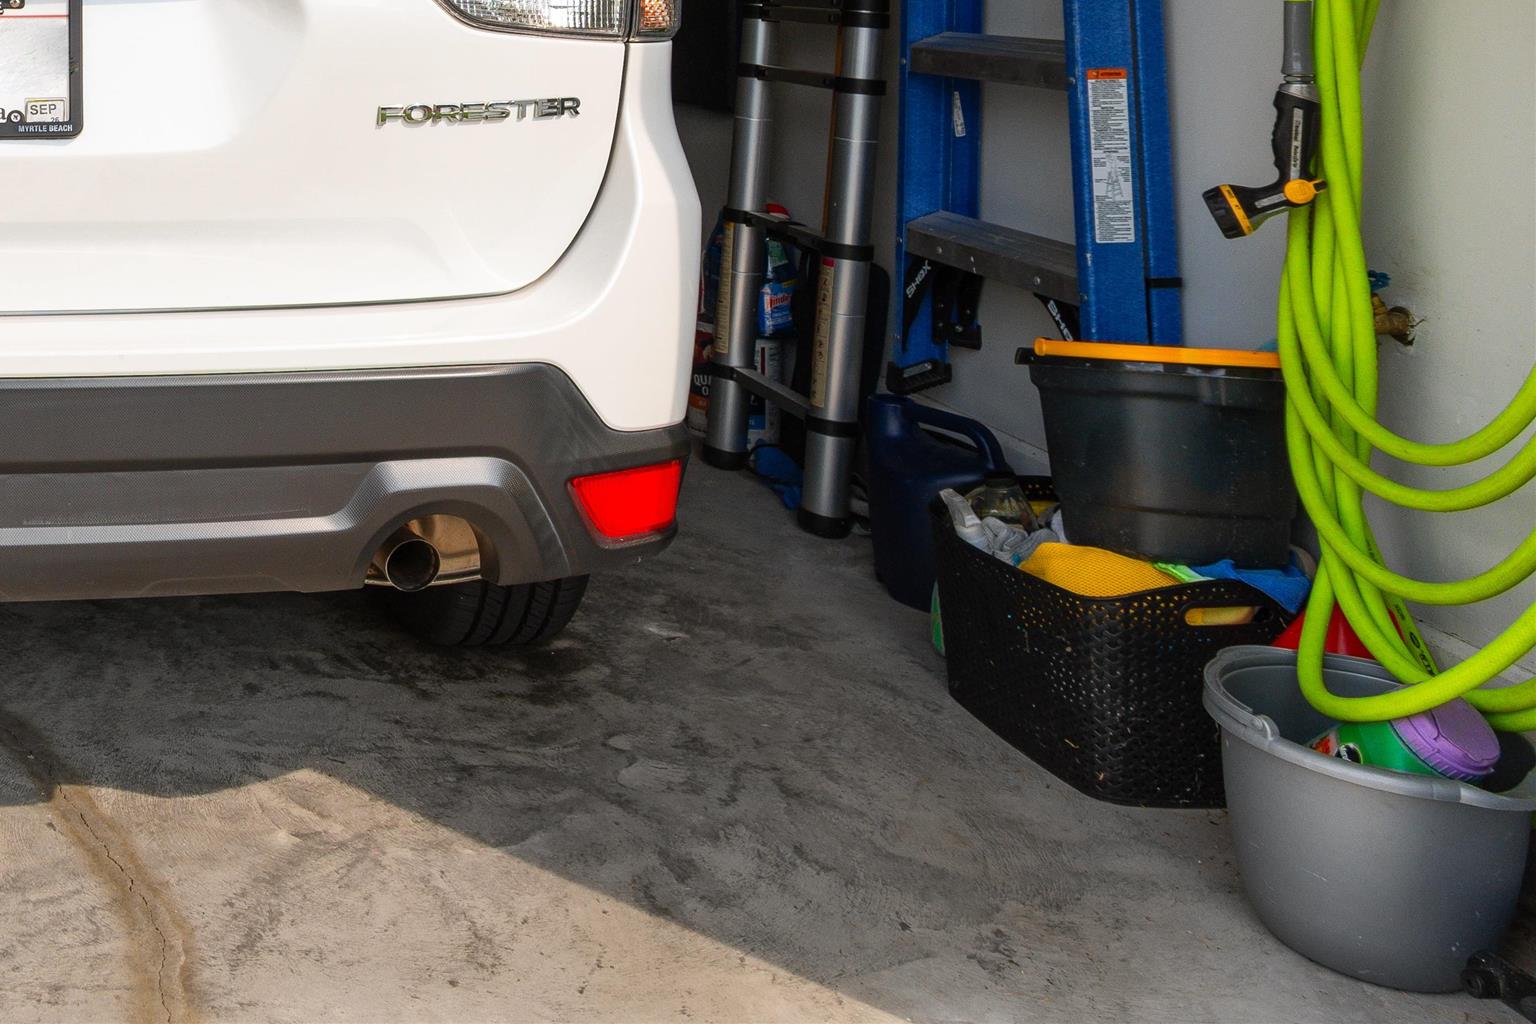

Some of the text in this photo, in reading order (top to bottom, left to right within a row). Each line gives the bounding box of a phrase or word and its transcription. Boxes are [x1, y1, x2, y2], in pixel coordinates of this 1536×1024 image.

[30, 103, 57, 115] SEP
[376, 97, 582, 126] FORESTER
[18, 124, 73, 133] MYRTLE BEACH
[1047, 299, 1074, 342] SHO
